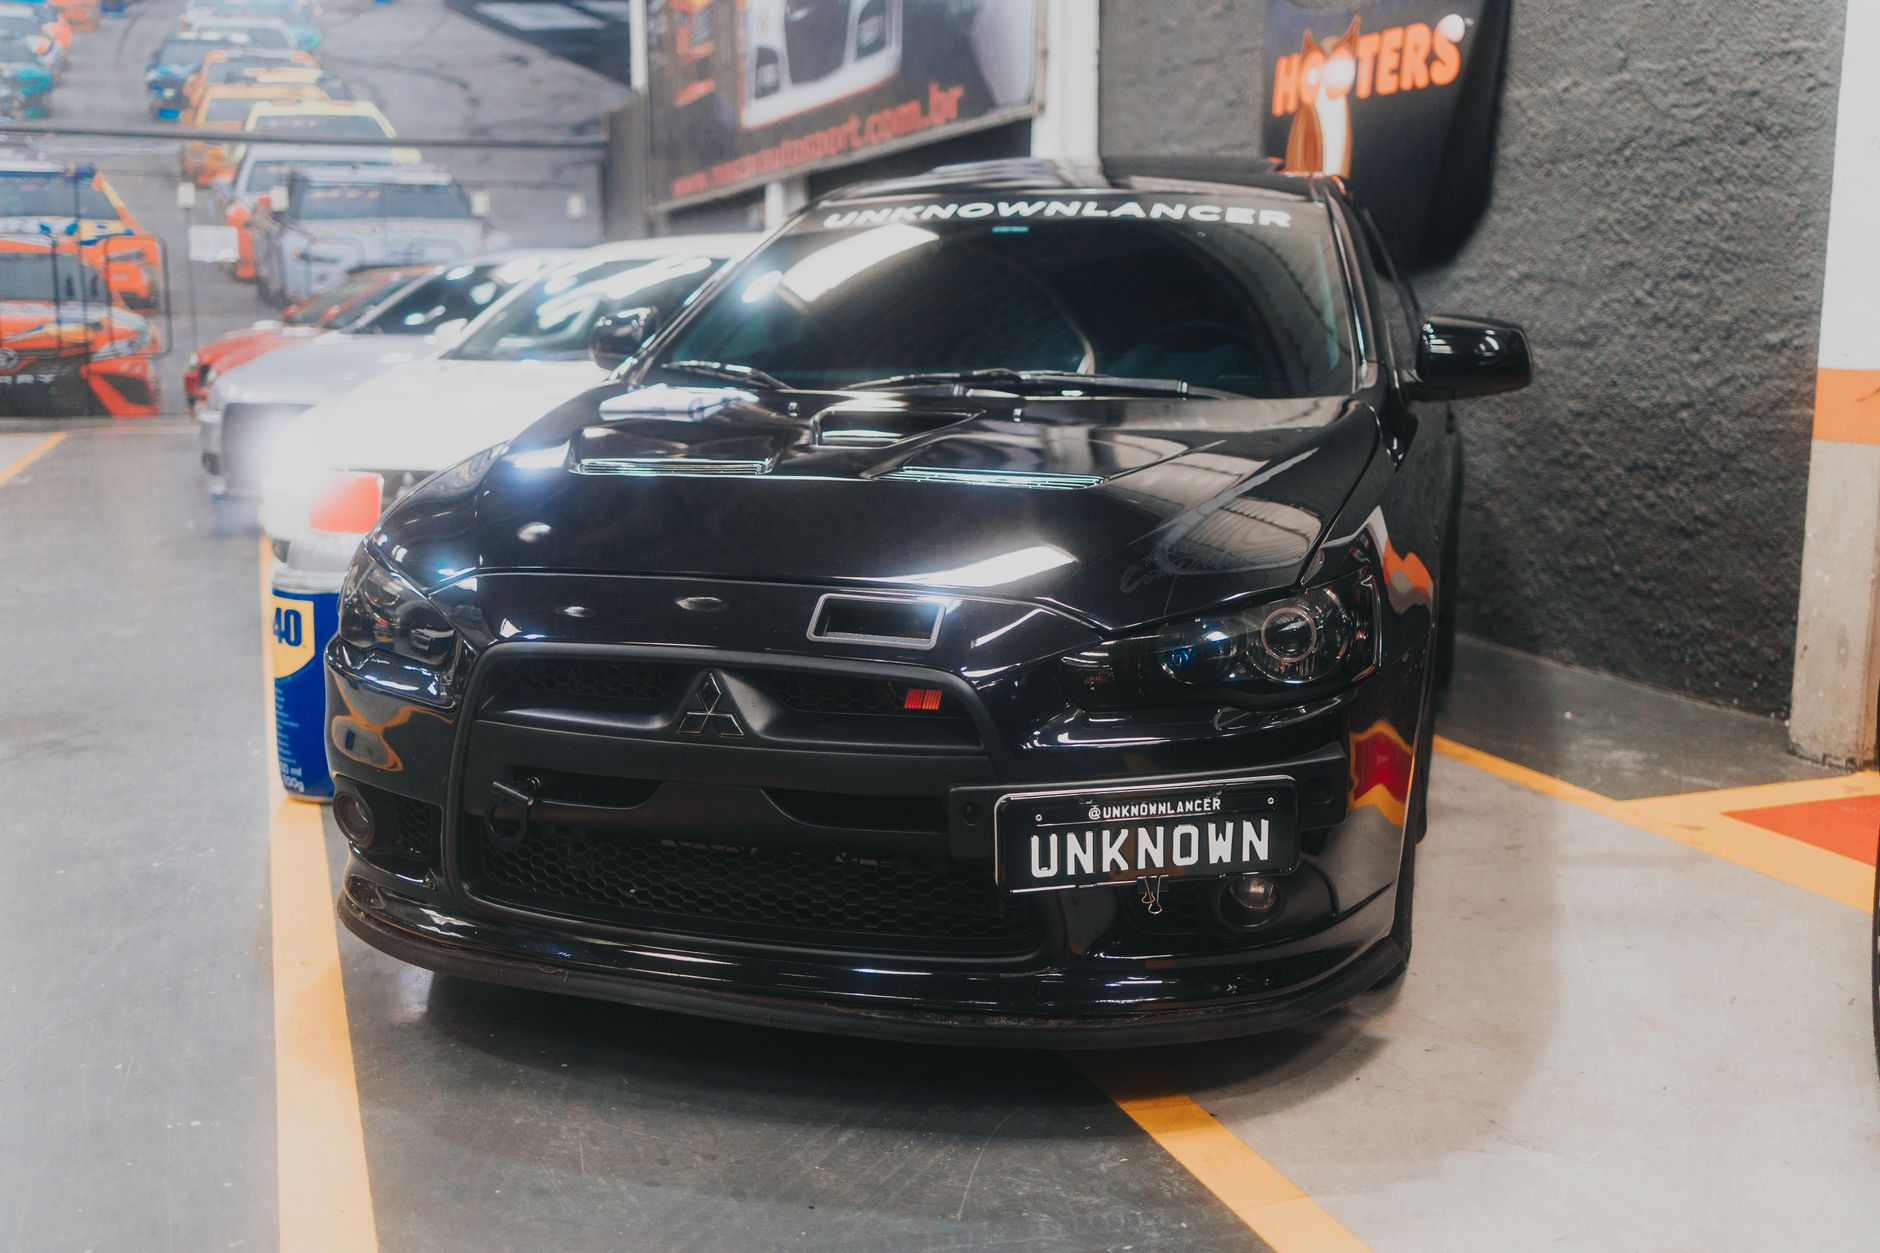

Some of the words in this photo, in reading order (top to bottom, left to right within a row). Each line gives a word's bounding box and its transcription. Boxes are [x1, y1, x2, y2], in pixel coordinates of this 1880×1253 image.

[1271, 18, 1463, 117] HOOTERS
[823, 200, 1292, 228] UNKNOWNLANCER
[273, 607, 303, 647] 40
[1088, 797, 1222, 821] @UNKNOWNLANCER
[1031, 818, 1270, 878] UNKNOWN
